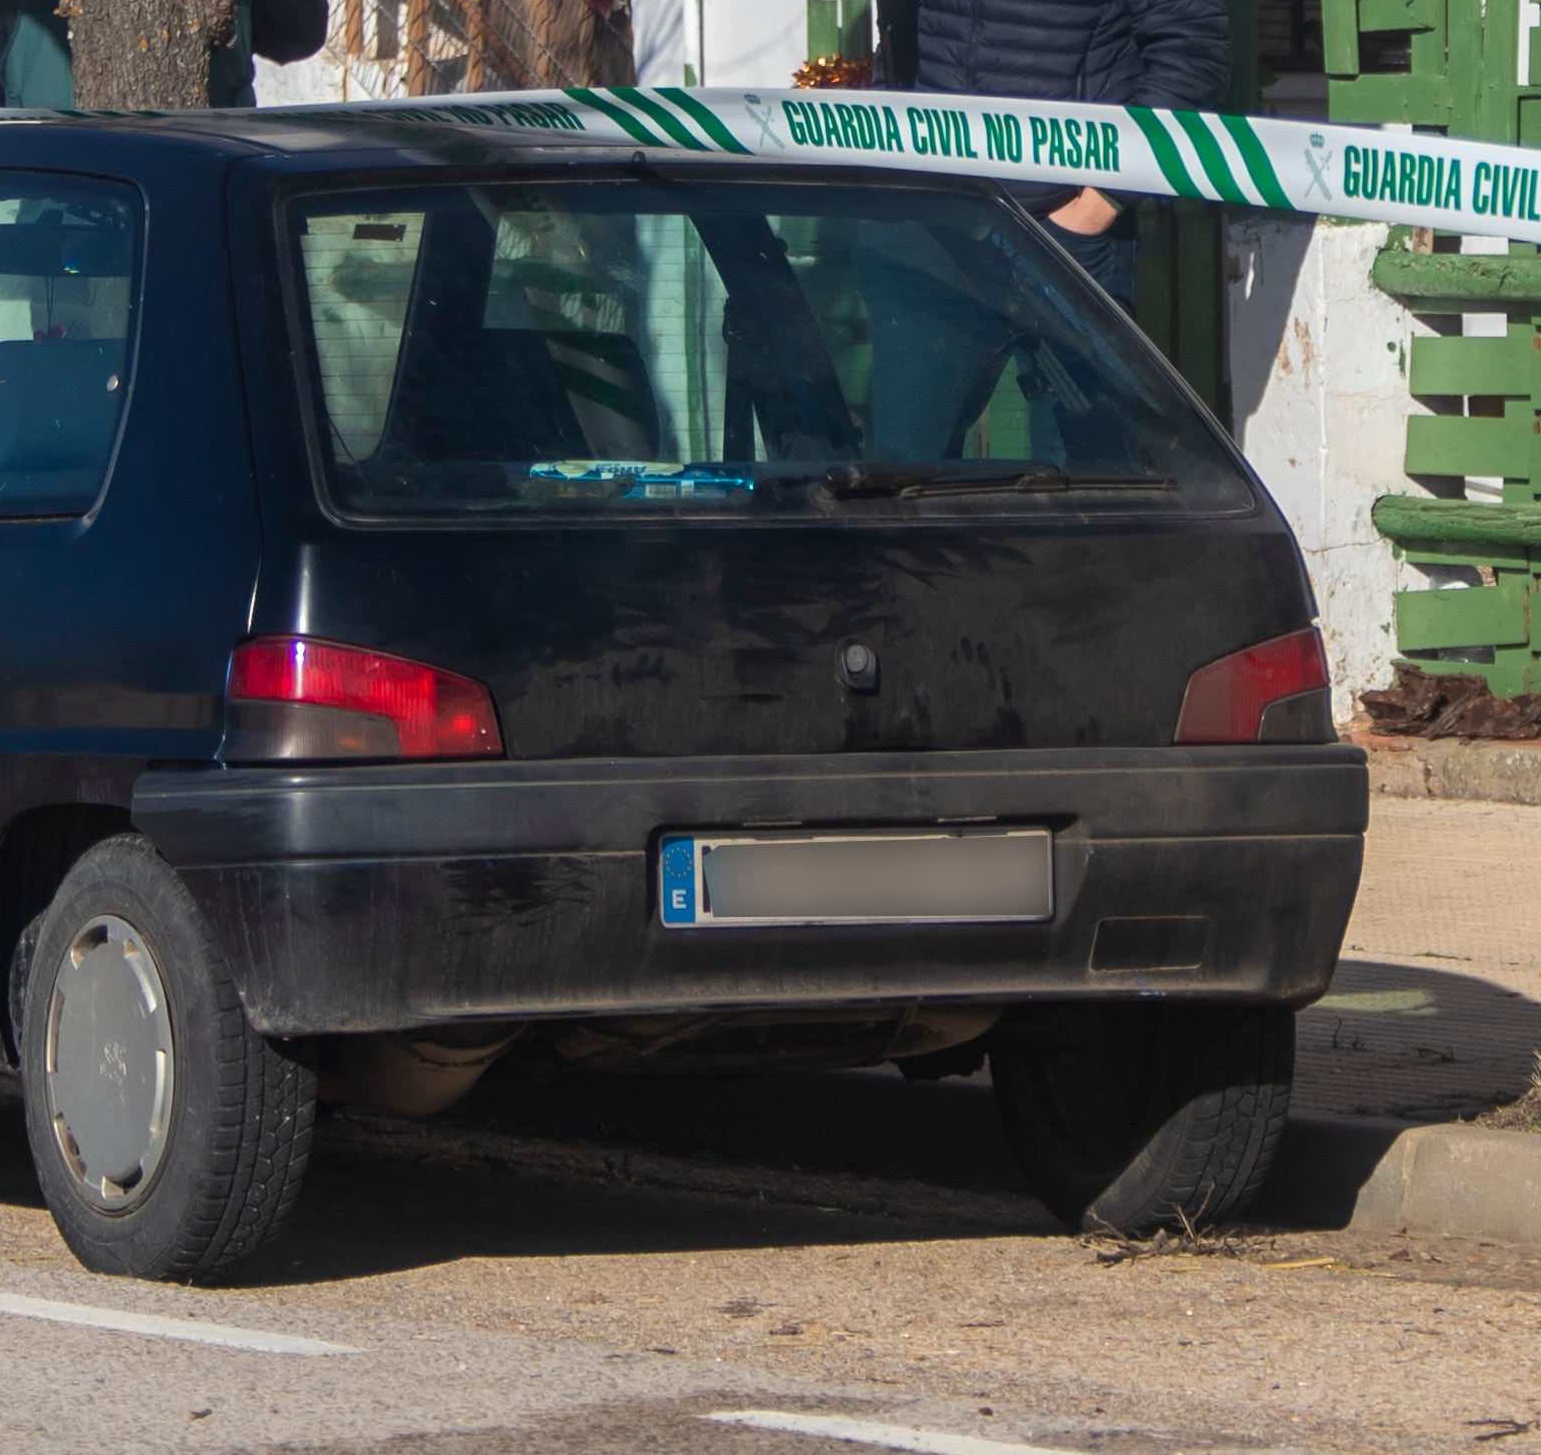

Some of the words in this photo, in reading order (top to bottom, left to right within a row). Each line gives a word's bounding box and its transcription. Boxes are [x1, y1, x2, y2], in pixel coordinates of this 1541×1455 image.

[474, 102, 586, 131] PASAR
[781, 99, 905, 153] GUARDIA
[906, 106, 979, 160] CIVIL
[981, 112, 1024, 164] NO
[1028, 116, 1121, 173] PASAR
[1343, 144, 1462, 211] GUARDIA
[1472, 161, 1541, 223] CIVIL
[672, 890, 686, 909] E
